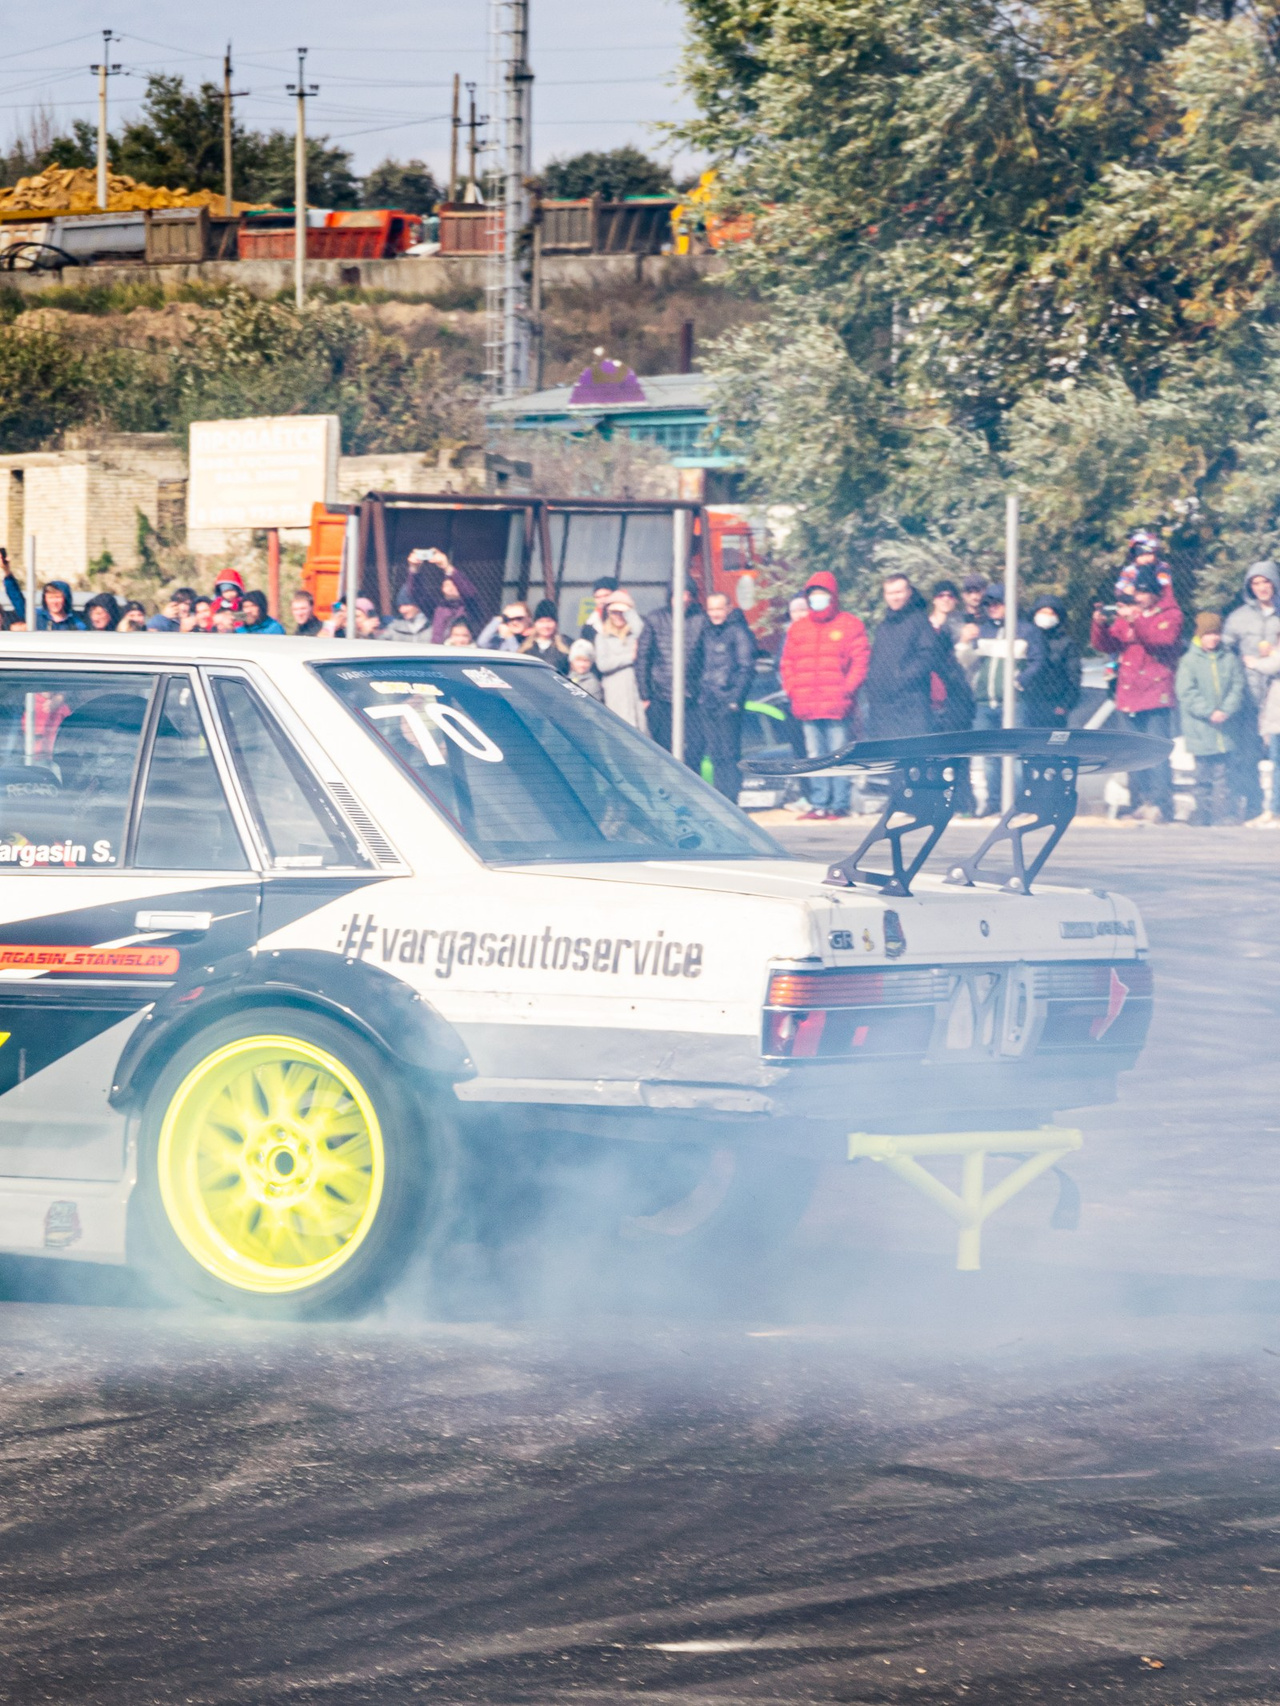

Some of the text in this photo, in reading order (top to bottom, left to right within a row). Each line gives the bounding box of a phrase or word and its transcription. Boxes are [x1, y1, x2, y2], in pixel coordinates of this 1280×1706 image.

[363, 703, 504, 766] 70
[92, 840, 116, 862] S.
[336, 913, 704, 979] #vargasautoservice
